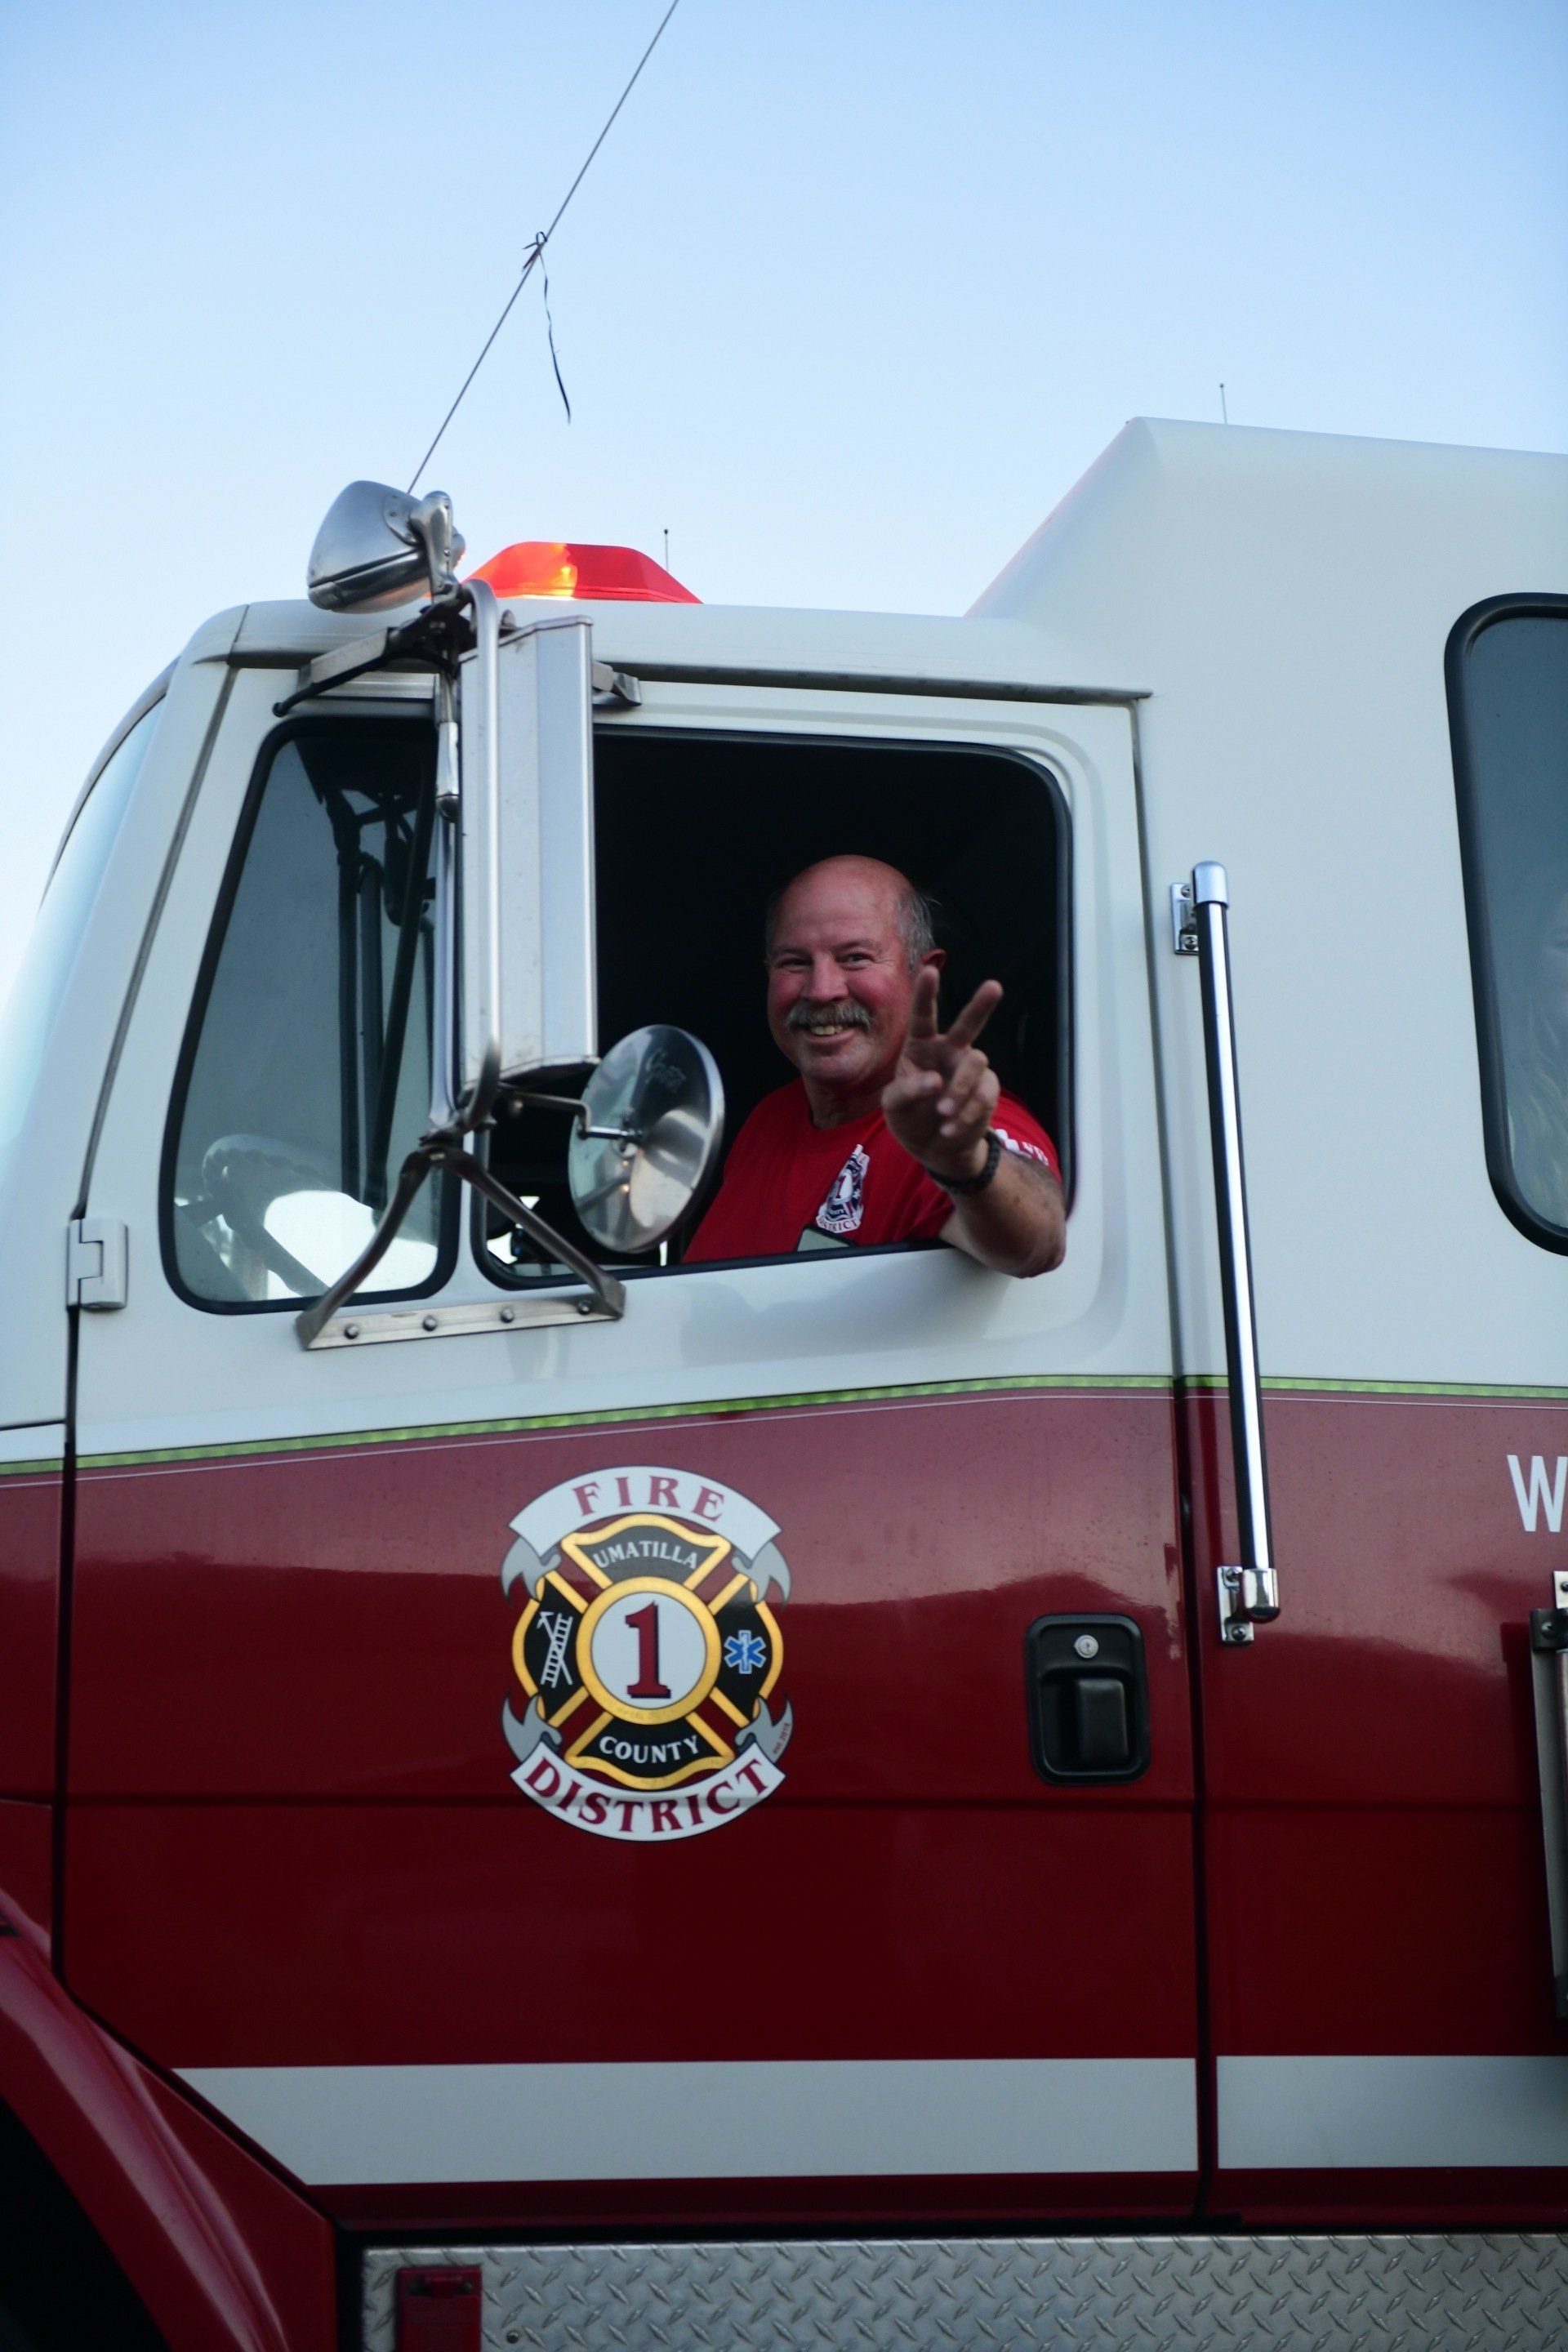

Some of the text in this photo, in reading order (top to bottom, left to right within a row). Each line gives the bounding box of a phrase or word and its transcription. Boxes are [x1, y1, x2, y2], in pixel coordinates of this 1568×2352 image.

[572, 1475, 726, 1523] FIRE
[1507, 1454, 1568, 1533] W
[593, 1540, 699, 1570] UMATILLA
[625, 1601, 671, 1699] 1
[599, 1735, 700, 1764] COUNTY
[523, 1757, 772, 1833] DISTRICT
